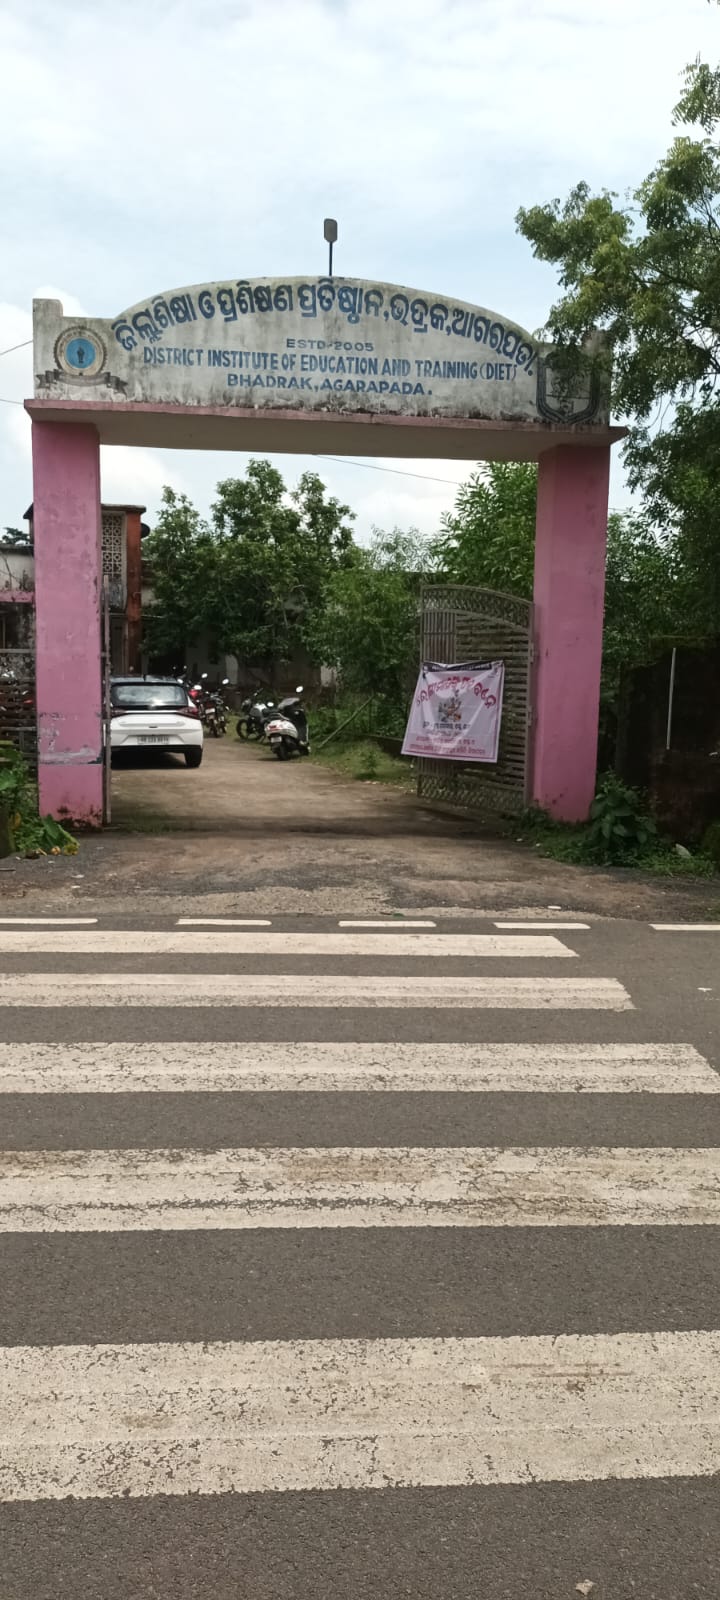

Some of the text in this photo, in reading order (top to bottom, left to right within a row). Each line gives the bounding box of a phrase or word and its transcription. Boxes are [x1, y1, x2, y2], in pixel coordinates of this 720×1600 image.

[198, 289, 215, 319] ଓ
[143, 346, 203, 367] DISTRICT
[208, 349, 278, 370] INSTITUTE
[281, 353, 296, 371] OF
[301, 354, 378, 375] EDUCATION
[381, 358, 411, 377] AND
[415, 359, 478, 380] TRAINING
